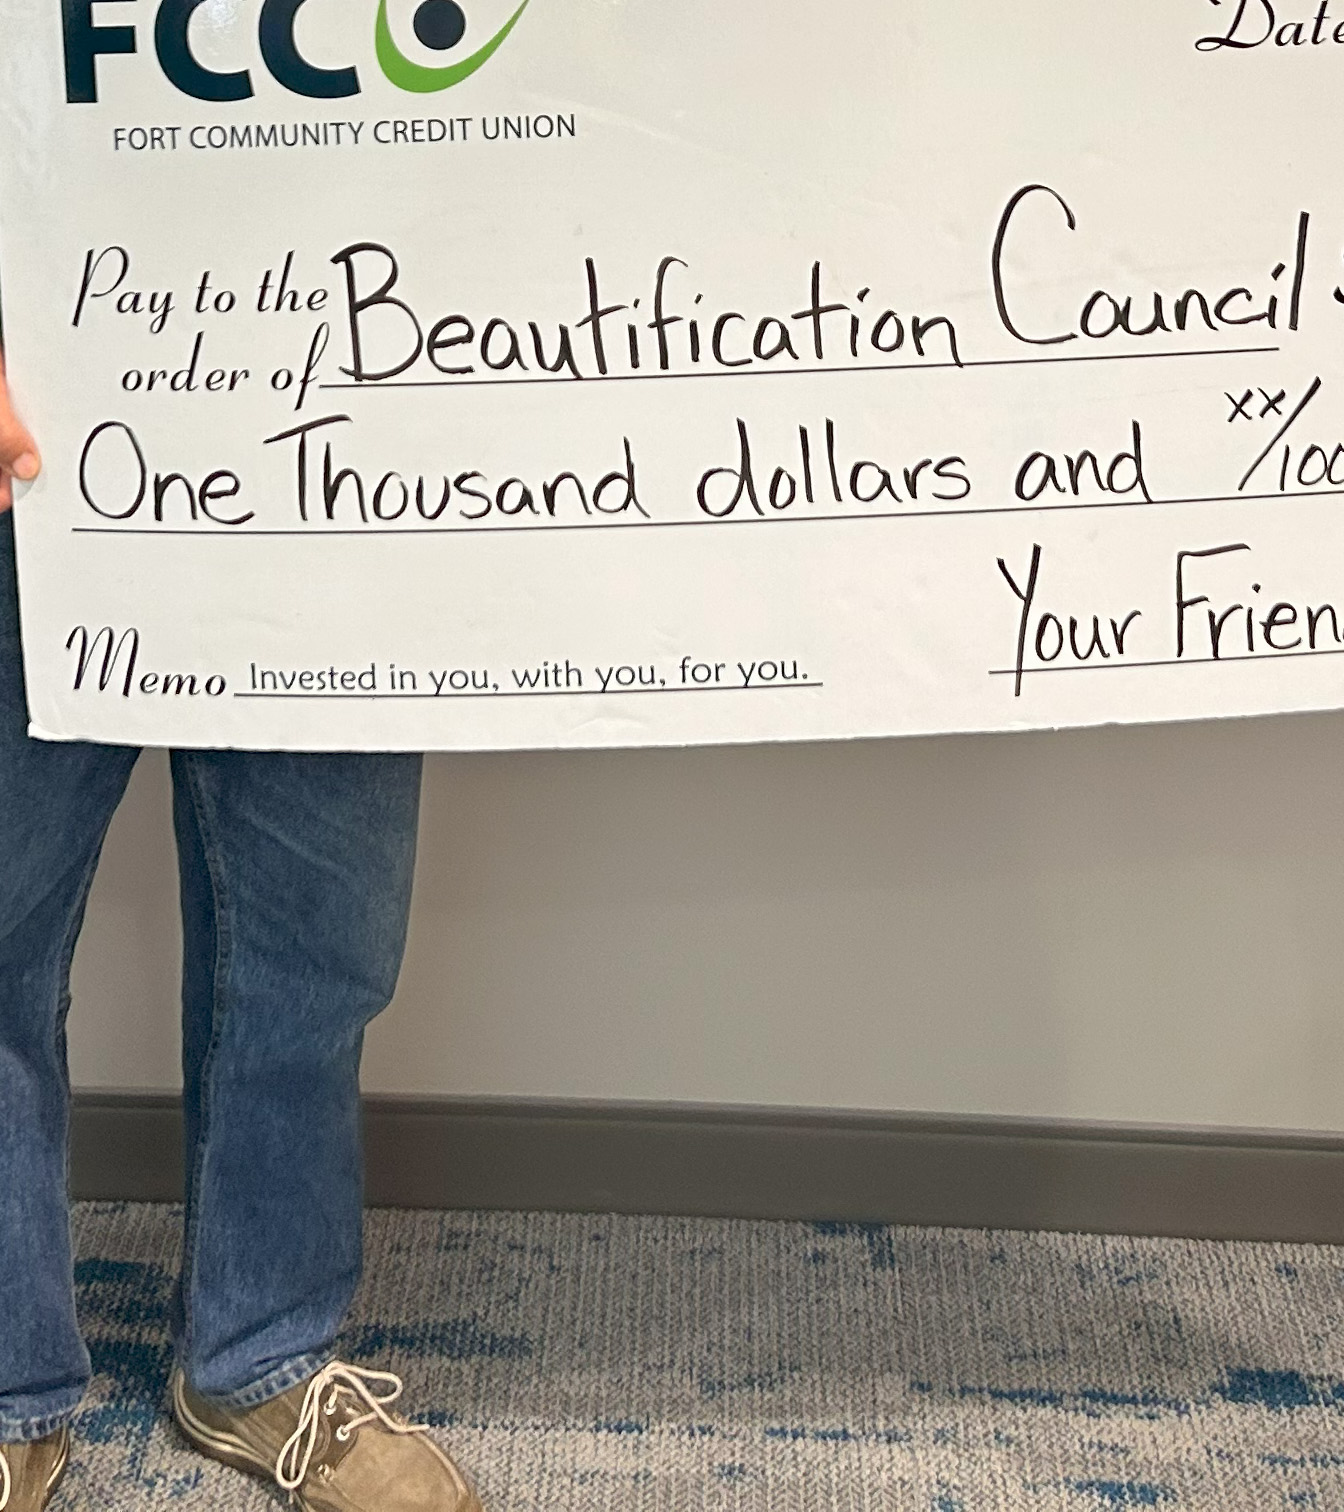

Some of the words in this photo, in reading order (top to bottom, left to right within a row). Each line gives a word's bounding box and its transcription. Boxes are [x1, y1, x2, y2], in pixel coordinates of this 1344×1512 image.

[113, 125, 182, 151] FORT
[189, 120, 361, 149] COMMUNITY
[373, 116, 473, 145] CREDIT
[481, 112, 577, 140] UNION
[72, 245, 174, 333] Pay
[196, 270, 236, 314] to
[256, 250, 329, 313] the
[330, 241, 963, 383] Beautification
[992, 185, 1310, 344] Council
[121, 331, 250, 392] order
[270, 322, 331, 411] of
[79, 420, 254, 525] One
[263, 414, 651, 523] Thousand
[697, 417, 972, 518] dollars
[1014, 419, 1154, 504] and
[65, 625, 228, 699] Memo
[996, 543, 1142, 697] Your
[248, 661, 376, 692] Invested
[389, 662, 418, 691] in
[428, 667, 500, 697] you,
[511, 659, 583, 689] with
[595, 664, 667, 694] you,
[679, 656, 726, 686] for
[736, 661, 810, 690] you.
